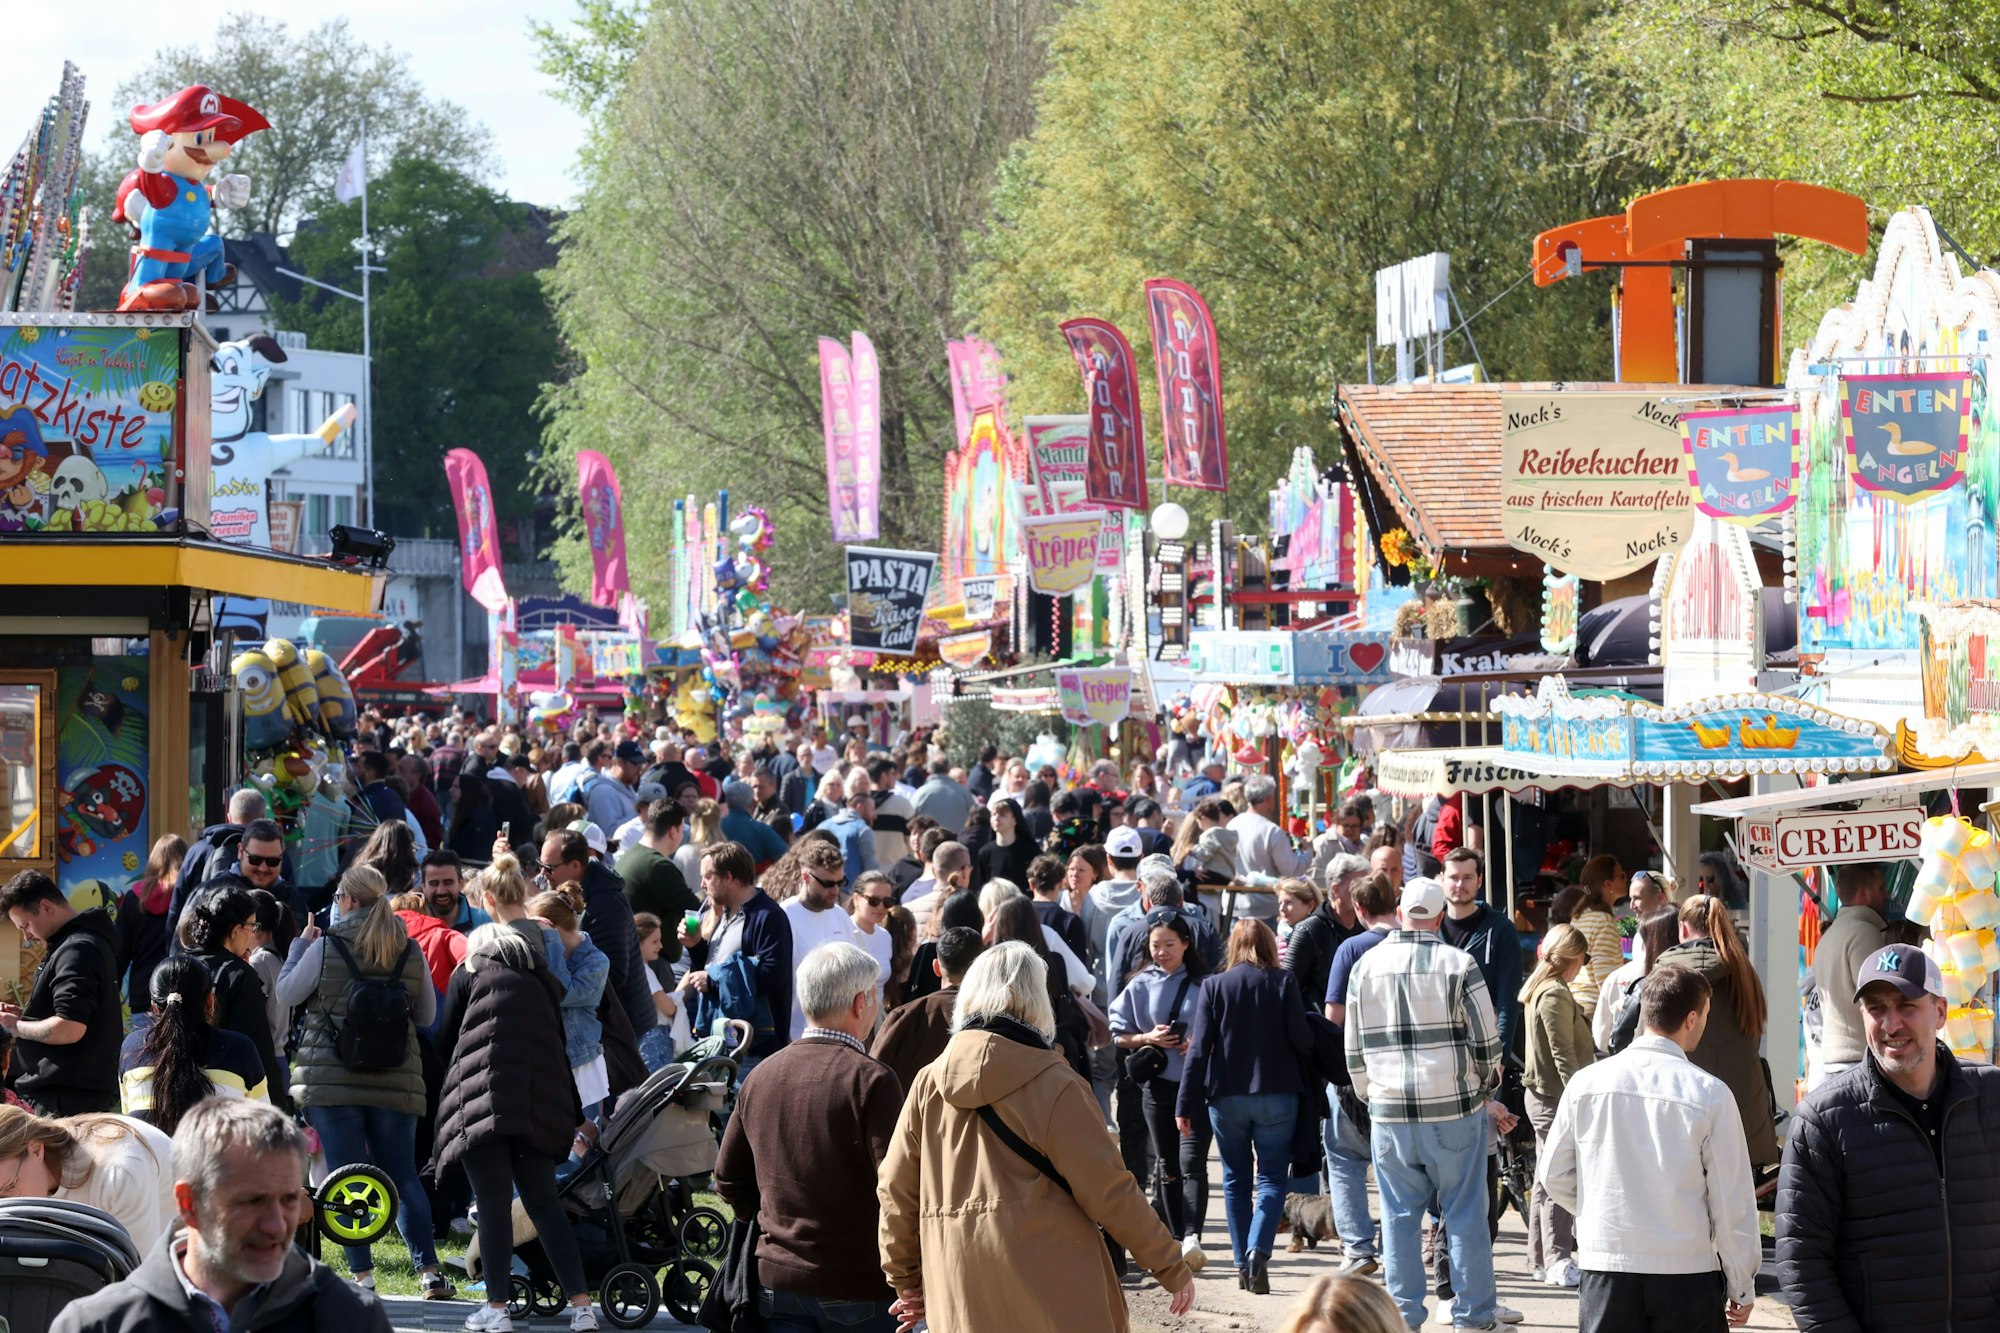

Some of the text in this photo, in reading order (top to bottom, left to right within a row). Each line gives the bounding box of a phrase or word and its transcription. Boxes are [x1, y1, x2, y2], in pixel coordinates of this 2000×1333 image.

[204, 97, 217, 112] M
[0, 355, 146, 449] atzkiste
[1174, 319, 1202, 479] FORCE
[1855, 389, 1957, 414] ENTEN
[1092, 353, 1123, 497] FORCE
[1507, 401, 1562, 431] Nock's
[1638, 401, 1680, 430] Nock
[1695, 421, 1786, 449] ENTEN
[1518, 448, 1679, 475] Reibekuchen
[1859, 449, 1956, 484] ANGELN
[210, 471, 259, 496] ladin
[1702, 476, 1790, 510] ANGELN
[1506, 489, 1690, 510] aus frischen Kartoffeln
[213, 510, 256, 523] Familien
[213, 524, 249, 534] russell
[1028, 535, 1098, 569] Crêpes
[1516, 525, 1572, 558] Nock's
[1625, 525, 1678, 560] Nock's
[849, 559, 928, 597] PASTA
[870, 604, 921, 627] Käse-
[880, 621, 914, 648] laib
[1327, 644, 1347, 675] I
[1441, 650, 1544, 675] Krak
[1082, 680, 1129, 705] Crêpes
[1780, 819, 1922, 858] CRÊPES
[1876, 951, 1900, 971] NY
